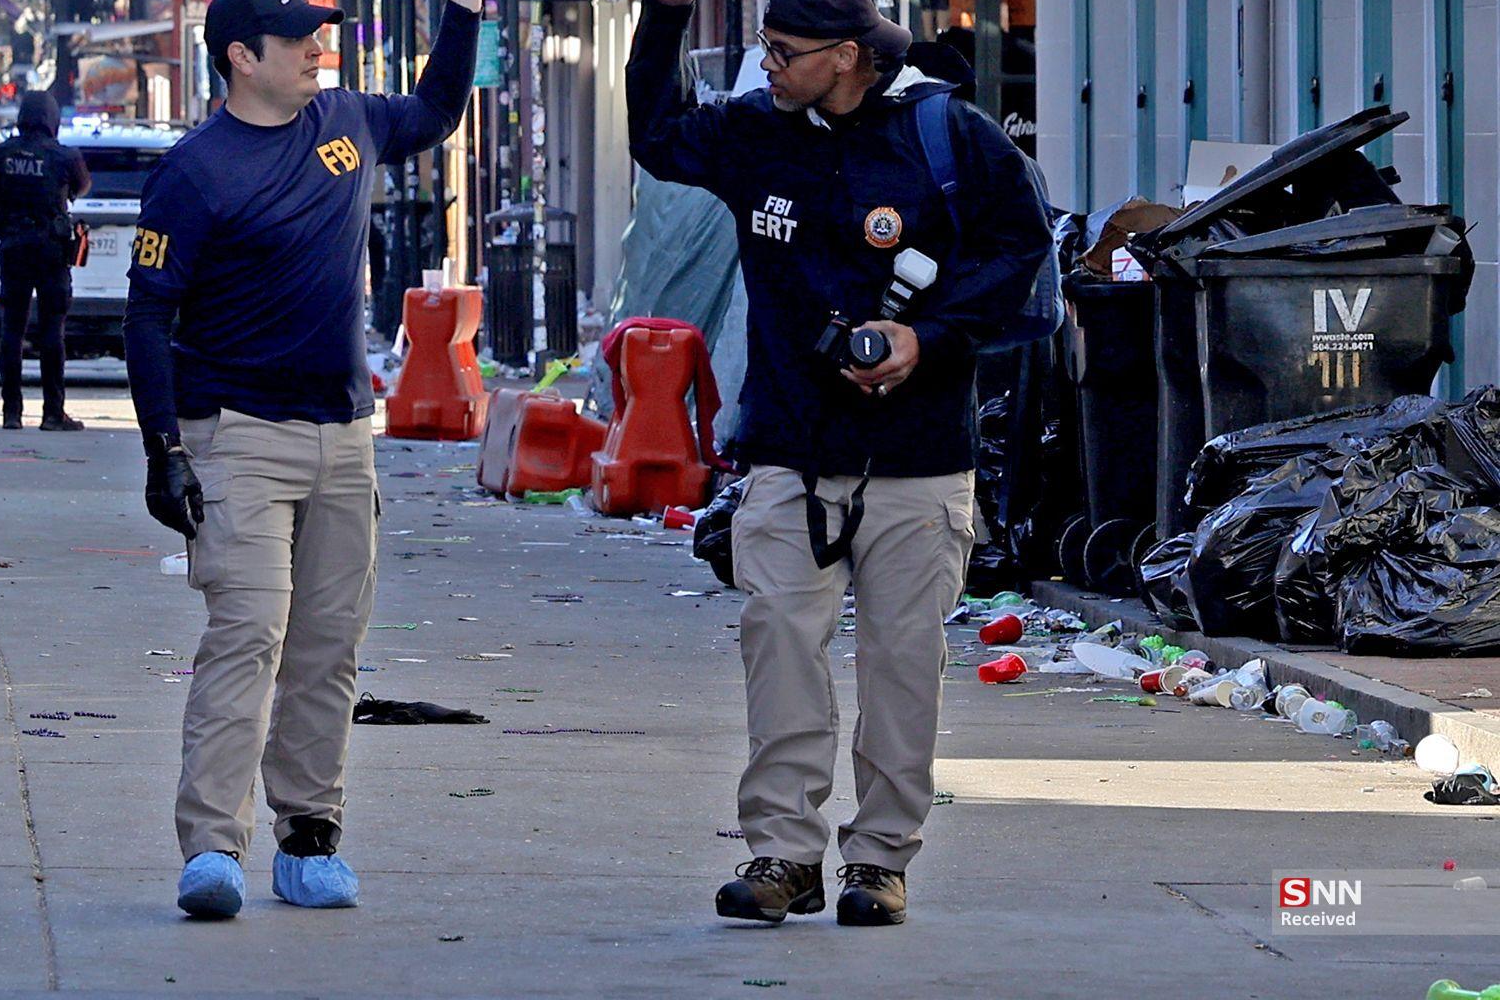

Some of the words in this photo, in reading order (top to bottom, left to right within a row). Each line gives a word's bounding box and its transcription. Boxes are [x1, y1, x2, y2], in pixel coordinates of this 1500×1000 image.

[316, 135, 360, 176] FBI
[764, 195, 793, 217] FBI
[752, 210, 798, 243] ERT
[132, 226, 169, 270] FBI
[1313, 288, 1372, 333] IV
[1312, 333, 1375, 342] ivwaste.com
[1312, 342, 1374, 352] 504.224.8471
